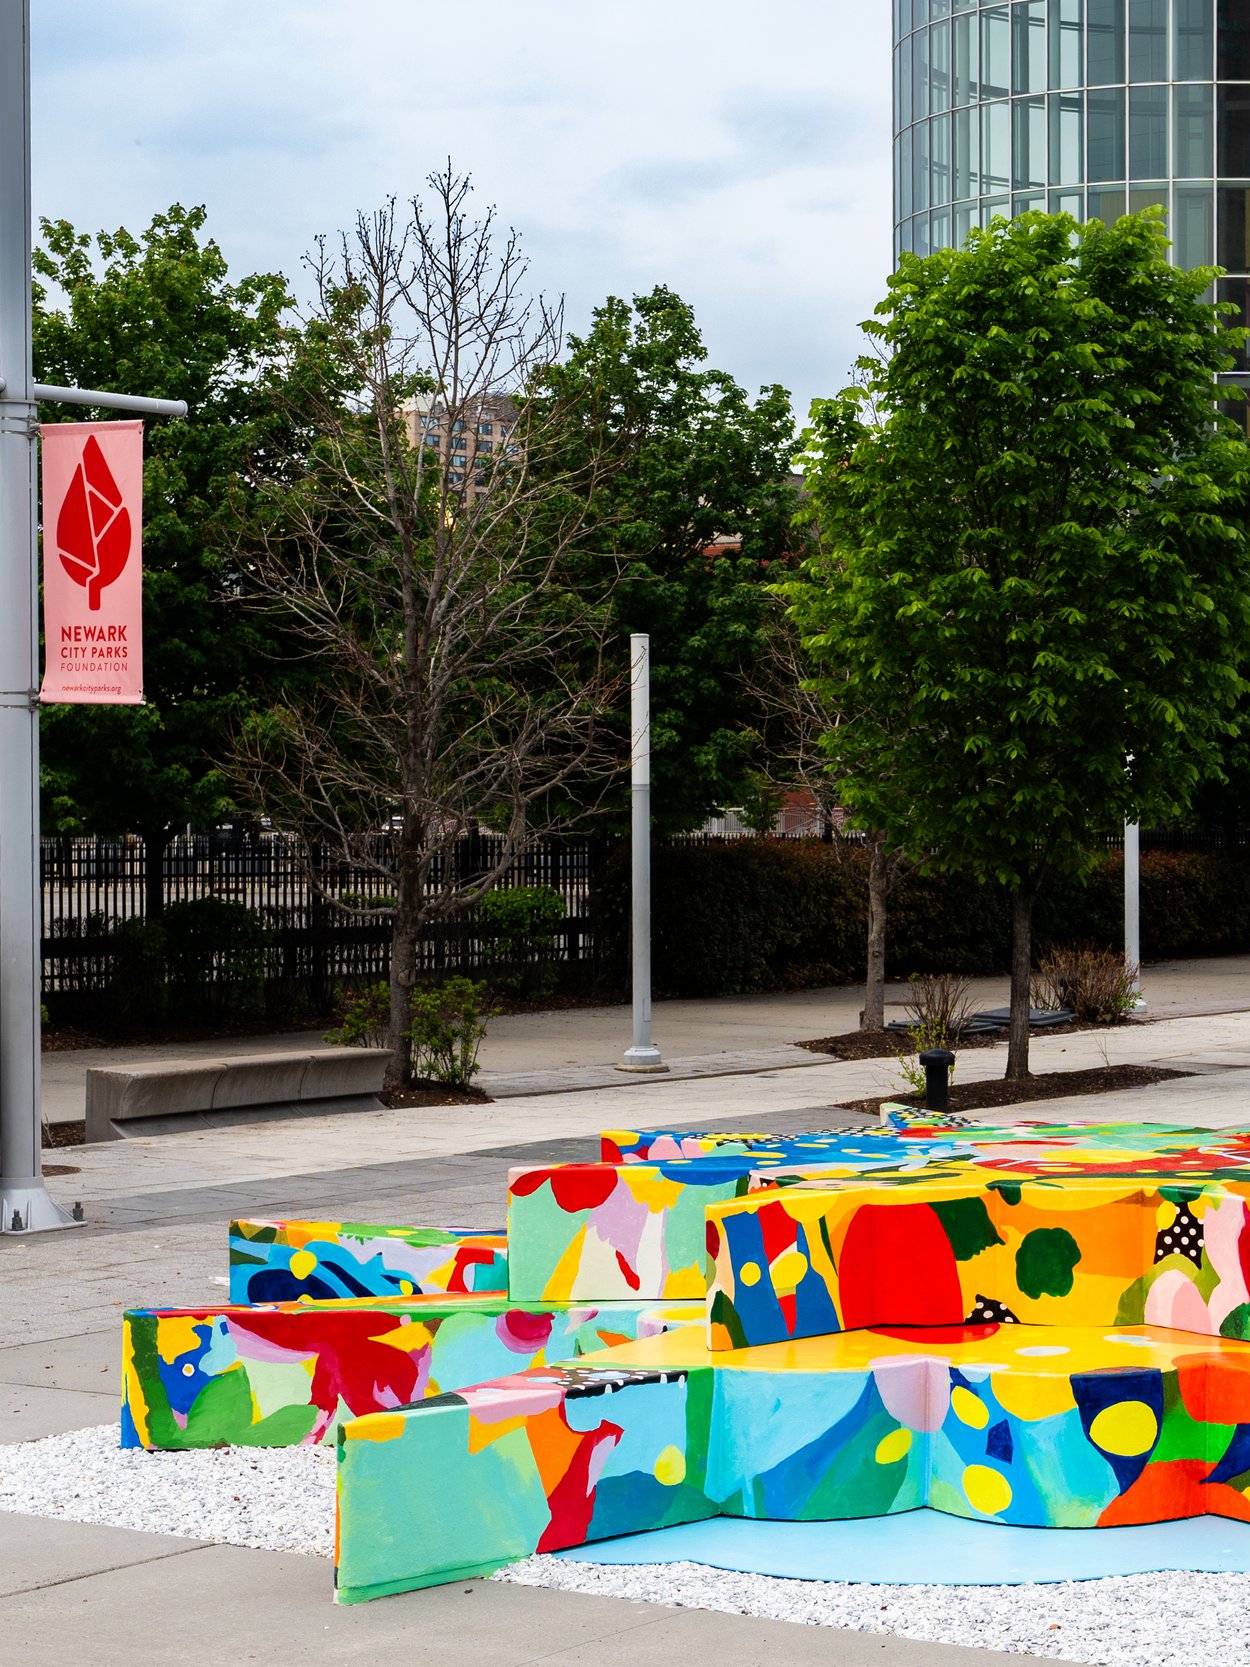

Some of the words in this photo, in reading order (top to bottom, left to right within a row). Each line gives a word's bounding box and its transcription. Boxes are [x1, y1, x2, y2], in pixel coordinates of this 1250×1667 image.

[61, 625, 127, 642] NEWARK
[60, 646, 87, 658] CITY
[91, 646, 128, 658] PARKS
[60, 662, 128, 672] FOUNDATION
[61, 685, 122, 695] newarkcityparks.org
